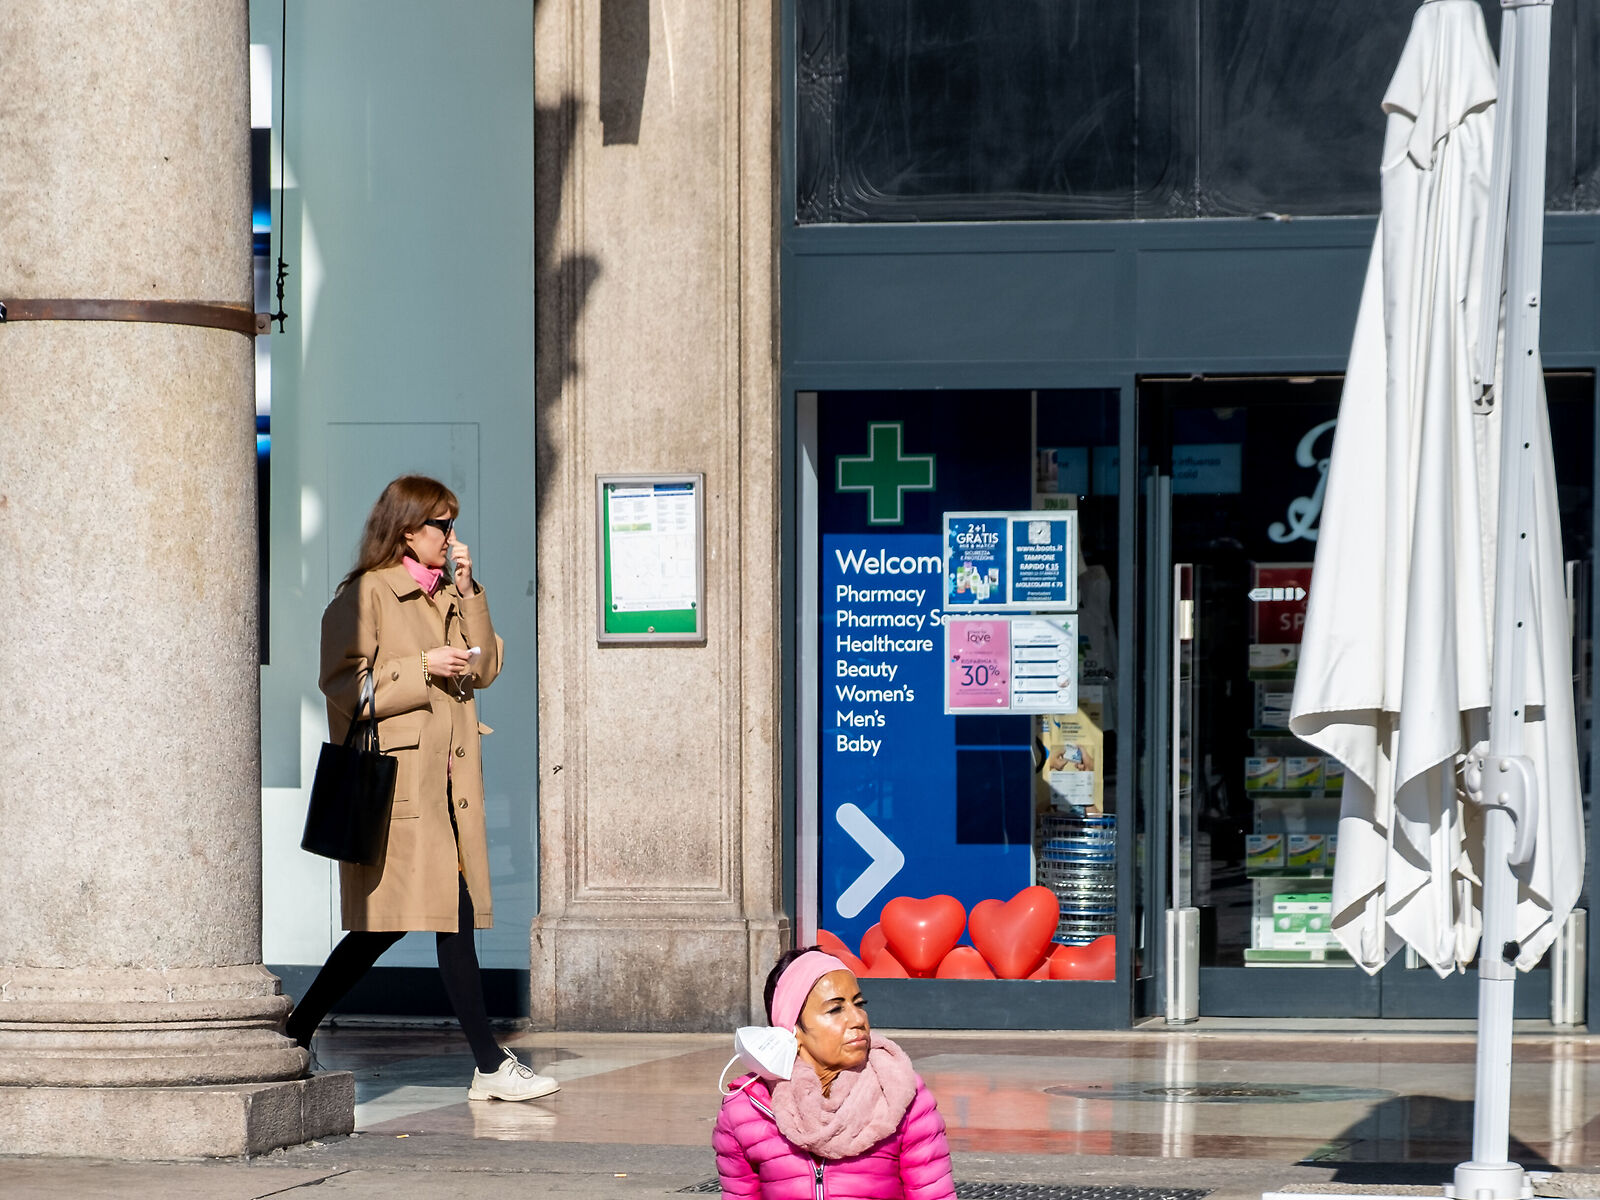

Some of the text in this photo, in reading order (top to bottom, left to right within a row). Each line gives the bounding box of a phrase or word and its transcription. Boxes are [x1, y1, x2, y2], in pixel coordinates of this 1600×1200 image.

[968, 523, 986, 533] 2+1
[956, 532, 999, 544] GRATIS
[1016, 544, 1063, 552] www.boots.it
[835, 548, 944, 575] Welcom
[836, 584, 926, 607] Pharmacy
[836, 609, 926, 632] Pharmacy
[836, 634, 934, 653] Healthcare
[967, 631, 991, 642] love
[836, 659, 898, 682] Beauty
[961, 665, 1000, 686] 30%
[835, 684, 915, 702] Women's
[836, 709, 886, 727] Men's
[836, 734, 882, 757] Baby
